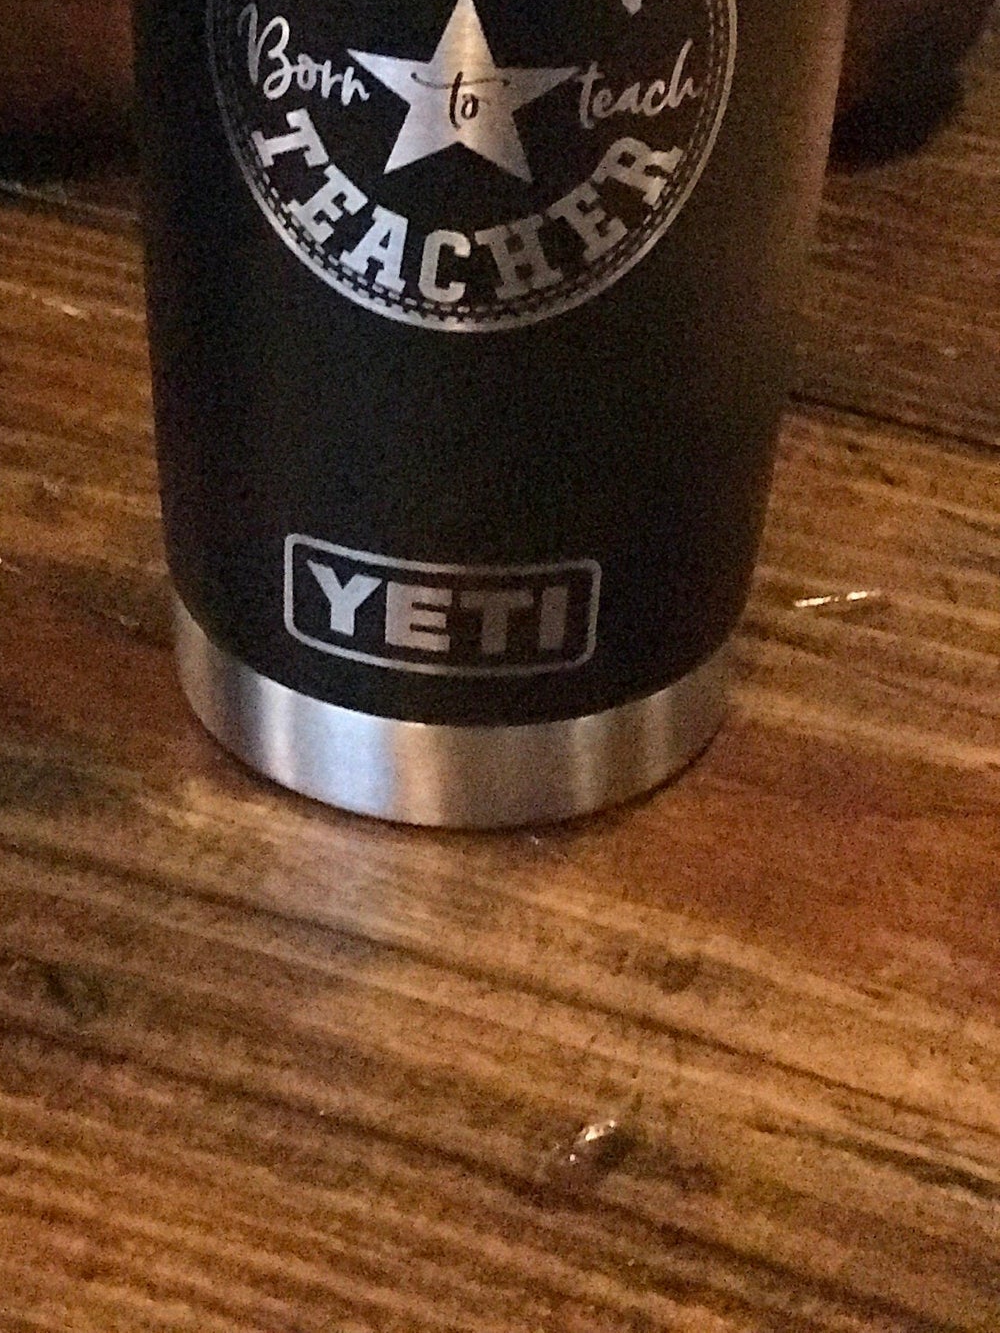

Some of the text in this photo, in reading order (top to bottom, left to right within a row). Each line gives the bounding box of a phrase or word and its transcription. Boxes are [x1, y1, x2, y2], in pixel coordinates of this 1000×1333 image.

[237, 3, 370, 106] Born
[573, 39, 700, 130] teach
[251, 109, 684, 304] TEACHER
[307, 559, 569, 654] YETI
